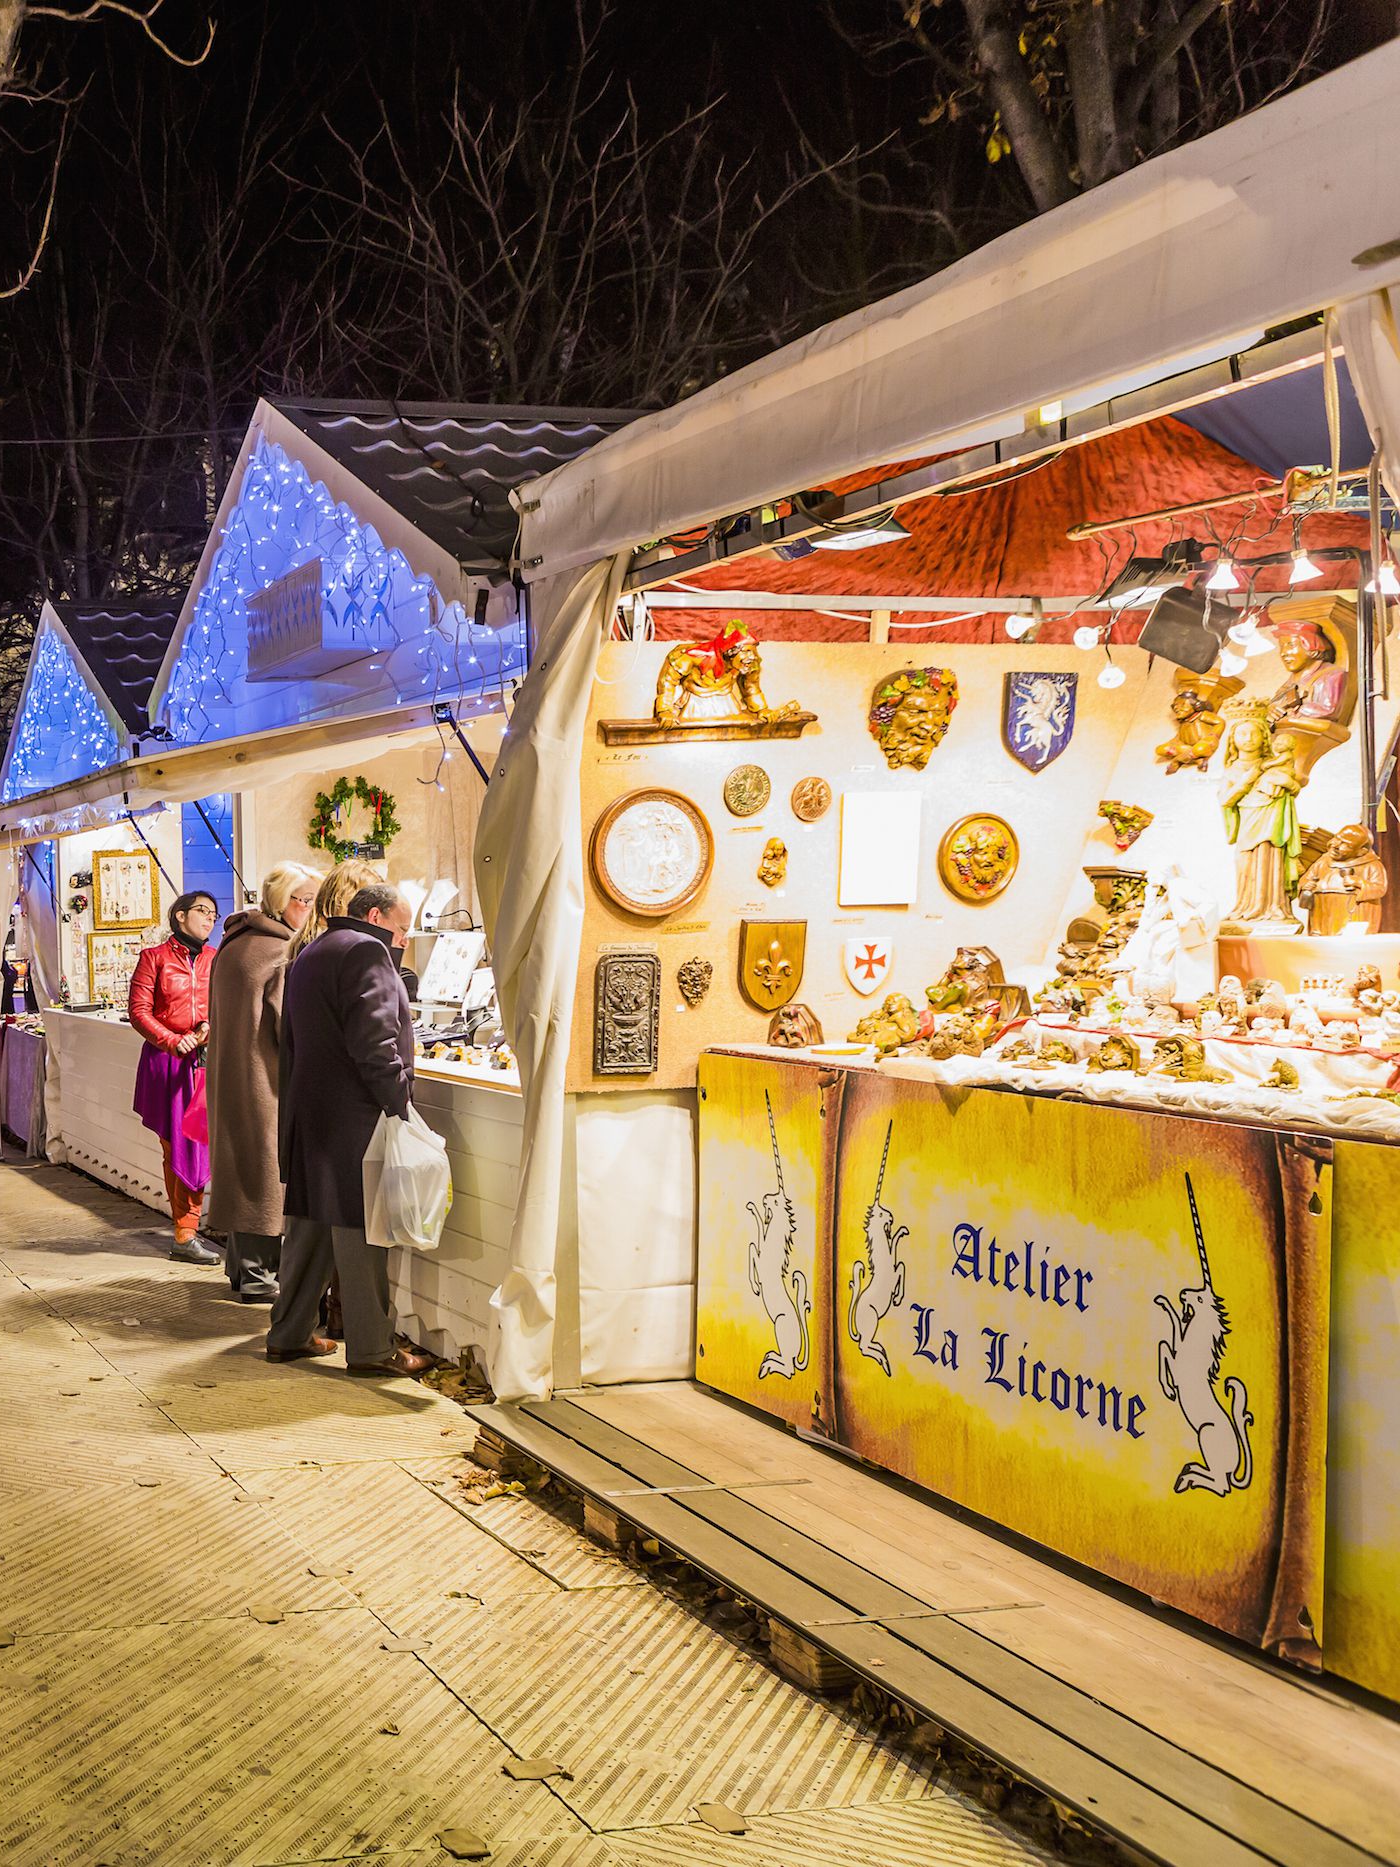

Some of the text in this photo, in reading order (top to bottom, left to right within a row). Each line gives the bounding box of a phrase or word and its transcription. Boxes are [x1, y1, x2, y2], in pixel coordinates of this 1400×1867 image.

[952, 1223, 1094, 1313] Atelier
[910, 1303, 1147, 1439] La Licorne
